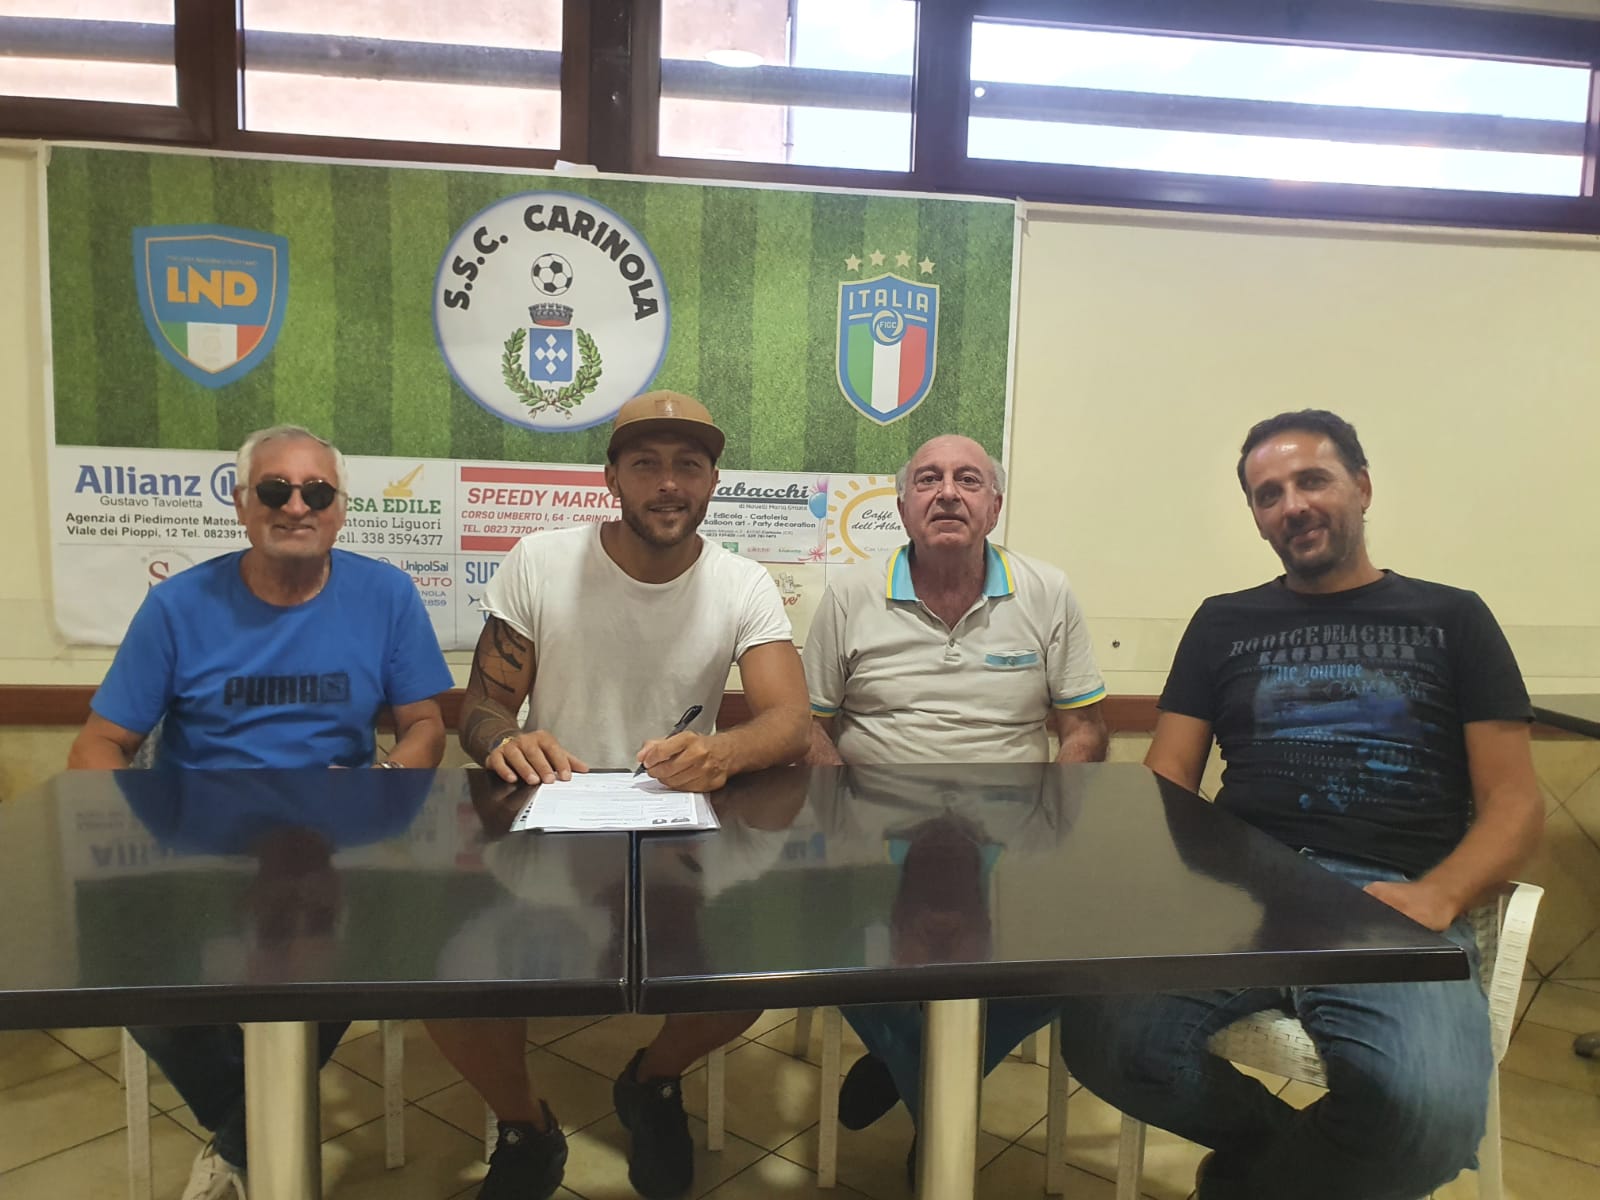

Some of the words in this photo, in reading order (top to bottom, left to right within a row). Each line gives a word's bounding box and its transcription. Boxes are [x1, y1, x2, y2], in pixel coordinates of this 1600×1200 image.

[443, 226, 509, 311] S.S.C.
[523, 204, 659, 321] CARINOLA
[166, 265, 258, 309] LND
[849, 289, 929, 313] ITALIA
[879, 321, 897, 329] FIGC
[74, 464, 202, 497] Allianz
[717, 480, 809, 499] abacchi
[99, 495, 149, 507] Gustavo
[152, 497, 203, 508] Tavoletta
[467, 487, 548, 507] SPEEDY
[551, 490, 622, 509] MARKE
[382, 498, 442, 514] EDILE
[65, 512, 116, 526] Agenzia
[119, 513, 131, 524] di
[134, 514, 200, 525] Piedimonte
[461, 510, 495, 520] CORSO
[497, 511, 542, 521] UMBERTO
[552, 513, 564, 521] 64
[344, 517, 388, 529] ntonio
[392, 517, 442, 531] Liguori
[463, 524, 480, 533] TEL.
[483, 525, 507, 534] 0823
[752, 520, 772, 528] Party
[67, 526, 97, 536] Viale
[100, 526, 118, 536] dei
[121, 527, 162, 539] Pioppi,
[166, 528, 178, 537] 12
[182, 528, 199, 538] Tel.
[203, 529, 248, 539] 0823911
[338, 531, 359, 543] ell.
[361, 532, 385, 544] 338
[388, 533, 443, 546] 3594377
[400, 560, 449, 575] UnipolSai
[412, 576, 453, 587] PUTO
[224, 675, 319, 706] PUMA
